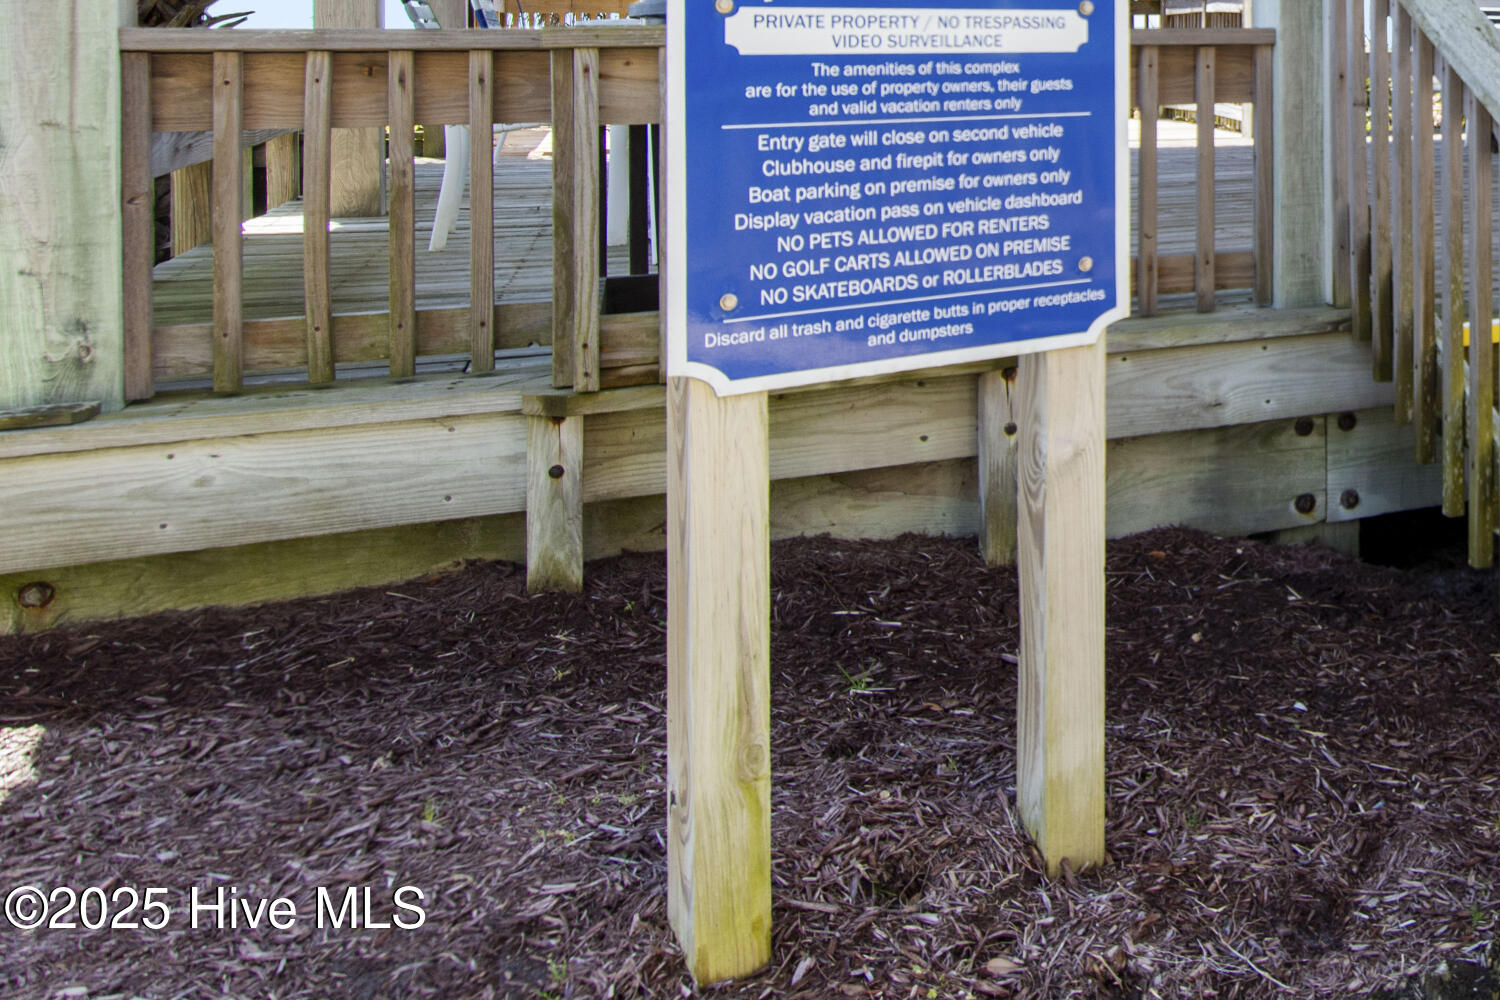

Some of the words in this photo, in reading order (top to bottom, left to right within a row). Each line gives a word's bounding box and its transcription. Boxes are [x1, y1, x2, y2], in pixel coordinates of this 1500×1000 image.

[753, 14, 825, 29] PRIVATE
[831, 14, 919, 30] PROPERTY
[922, 15, 932, 32] /
[937, 15, 960, 30] NO
[965, 15, 1066, 30] TRESPASSING
[832, 33, 882, 48] VIDEO
[887, 33, 1003, 48] SURVEILLANCE
[811, 62, 840, 77] The
[843, 61, 916, 76] amenities
[918, 60, 932, 75] of
[936, 60, 962, 75] this
[964, 60, 1020, 77] complex
[745, 84, 772, 98] are
[775, 82, 797, 97] for
[801, 82, 828, 97] the
[831, 84, 858, 96] use
[861, 80, 877, 95] of
[880, 80, 939, 98] property
[941, 83, 994, 94] owners,
[997, 78, 1028, 92] their
[1030, 78, 1073, 94] guests
[809, 100, 838, 116] and
[842, 99, 877, 115] valid
[880, 98, 940, 114] vacation
[943, 97, 992, 112] renters
[994, 95, 1023, 112] only
[757, 134, 804, 153] Entry
[808, 132, 846, 152] gate
[850, 131, 878, 147] will
[881, 129, 925, 145] close
[928, 130, 949, 143] on
[952, 124, 1009, 142] second
[1011, 122, 1064, 139] vehicle
[762, 157, 855, 177] Clubhouse
[859, 154, 892, 171] and
[896, 150, 944, 171] firepit
[946, 150, 968, 166] for
[971, 148, 1027, 165] owners
[1029, 145, 1061, 164] only
[748, 185, 791, 203] Boat
[795, 181, 861, 203] parking
[864, 180, 886, 196] on
[890, 175, 955, 197] premise
[958, 173, 979, 189] for
[982, 171, 1037, 188] owners
[1039, 167, 1071, 186] only
[734, 211, 800, 231] Display
[803, 205, 876, 225] vacation
[880, 204, 920, 222] pass
[923, 200, 944, 215] on
[947, 195, 1002, 214] vehicle
[1004, 189, 1083, 210] dashboard
[777, 235, 805, 252] NO
[808, 230, 853, 250] PETS
[858, 223, 938, 246] ALLOWED
[942, 220, 974, 238] FOR
[978, 214, 1050, 235] RENTERS
[750, 262, 778, 281] NO
[782, 257, 830, 278] GOLF
[834, 252, 890, 273] CARTS
[894, 243, 972, 267] ALLOWED
[975, 241, 999, 259] ON
[1003, 235, 1071, 256] PREMISE
[760, 287, 788, 306] NO
[792, 273, 919, 302] SKATEBOARDS
[922, 273, 939, 288] or
[943, 258, 1063, 286] ROLLERBLADES
[705, 327, 765, 348] Discard
[769, 324, 788, 340] all
[791, 319, 831, 338] trash
[835, 315, 864, 333] and
[867, 306, 930, 330] cigarette
[933, 300, 969, 320] butts
[972, 298, 985, 314] in
[987, 298, 1030, 316] proper
[1033, 288, 1106, 309] receptacles
[867, 329, 895, 347] and
[899, 321, 974, 344] dumpsters
